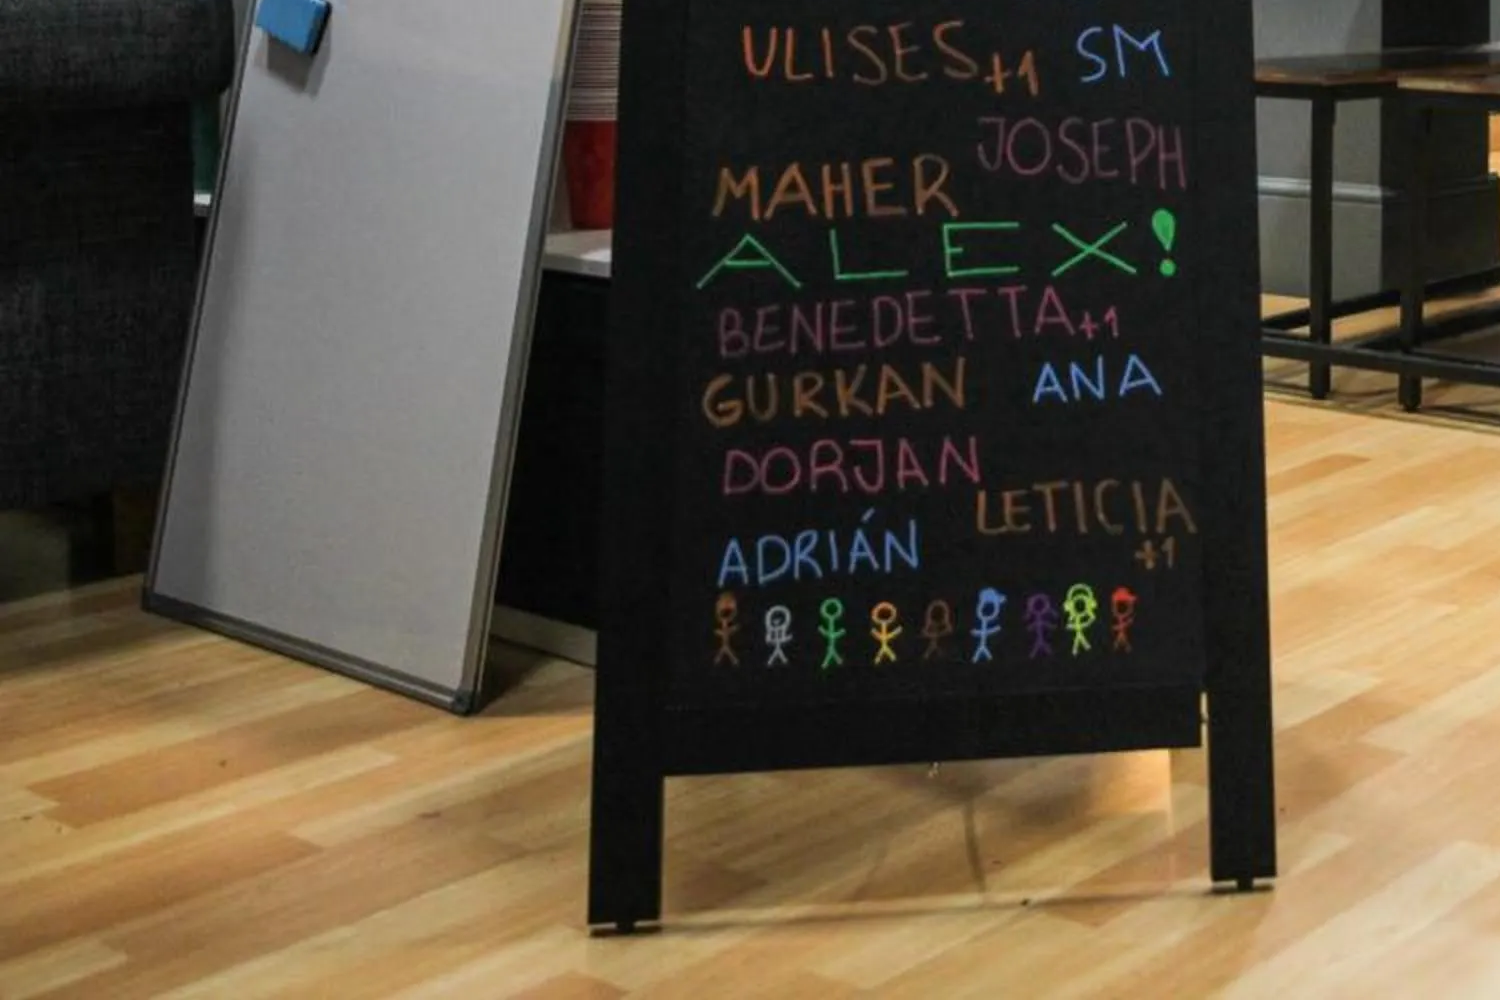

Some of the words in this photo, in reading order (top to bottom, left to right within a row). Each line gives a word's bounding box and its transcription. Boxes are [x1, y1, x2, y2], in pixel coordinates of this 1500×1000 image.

[1076, 23, 1171, 84] SM
[976, 116, 1188, 190] JOSEPH
[711, 154, 960, 221] MAHER
[696, 207, 1178, 289] ALEX!
[701, 356, 967, 428] GURKAN
[1031, 353, 1163, 404] ANA
[722, 435, 982, 496] DORJAN
[975, 478, 1197, 535] LETICIA
[717, 507, 920, 588] ADRIÁN
[1133, 536, 1177, 571] +1
